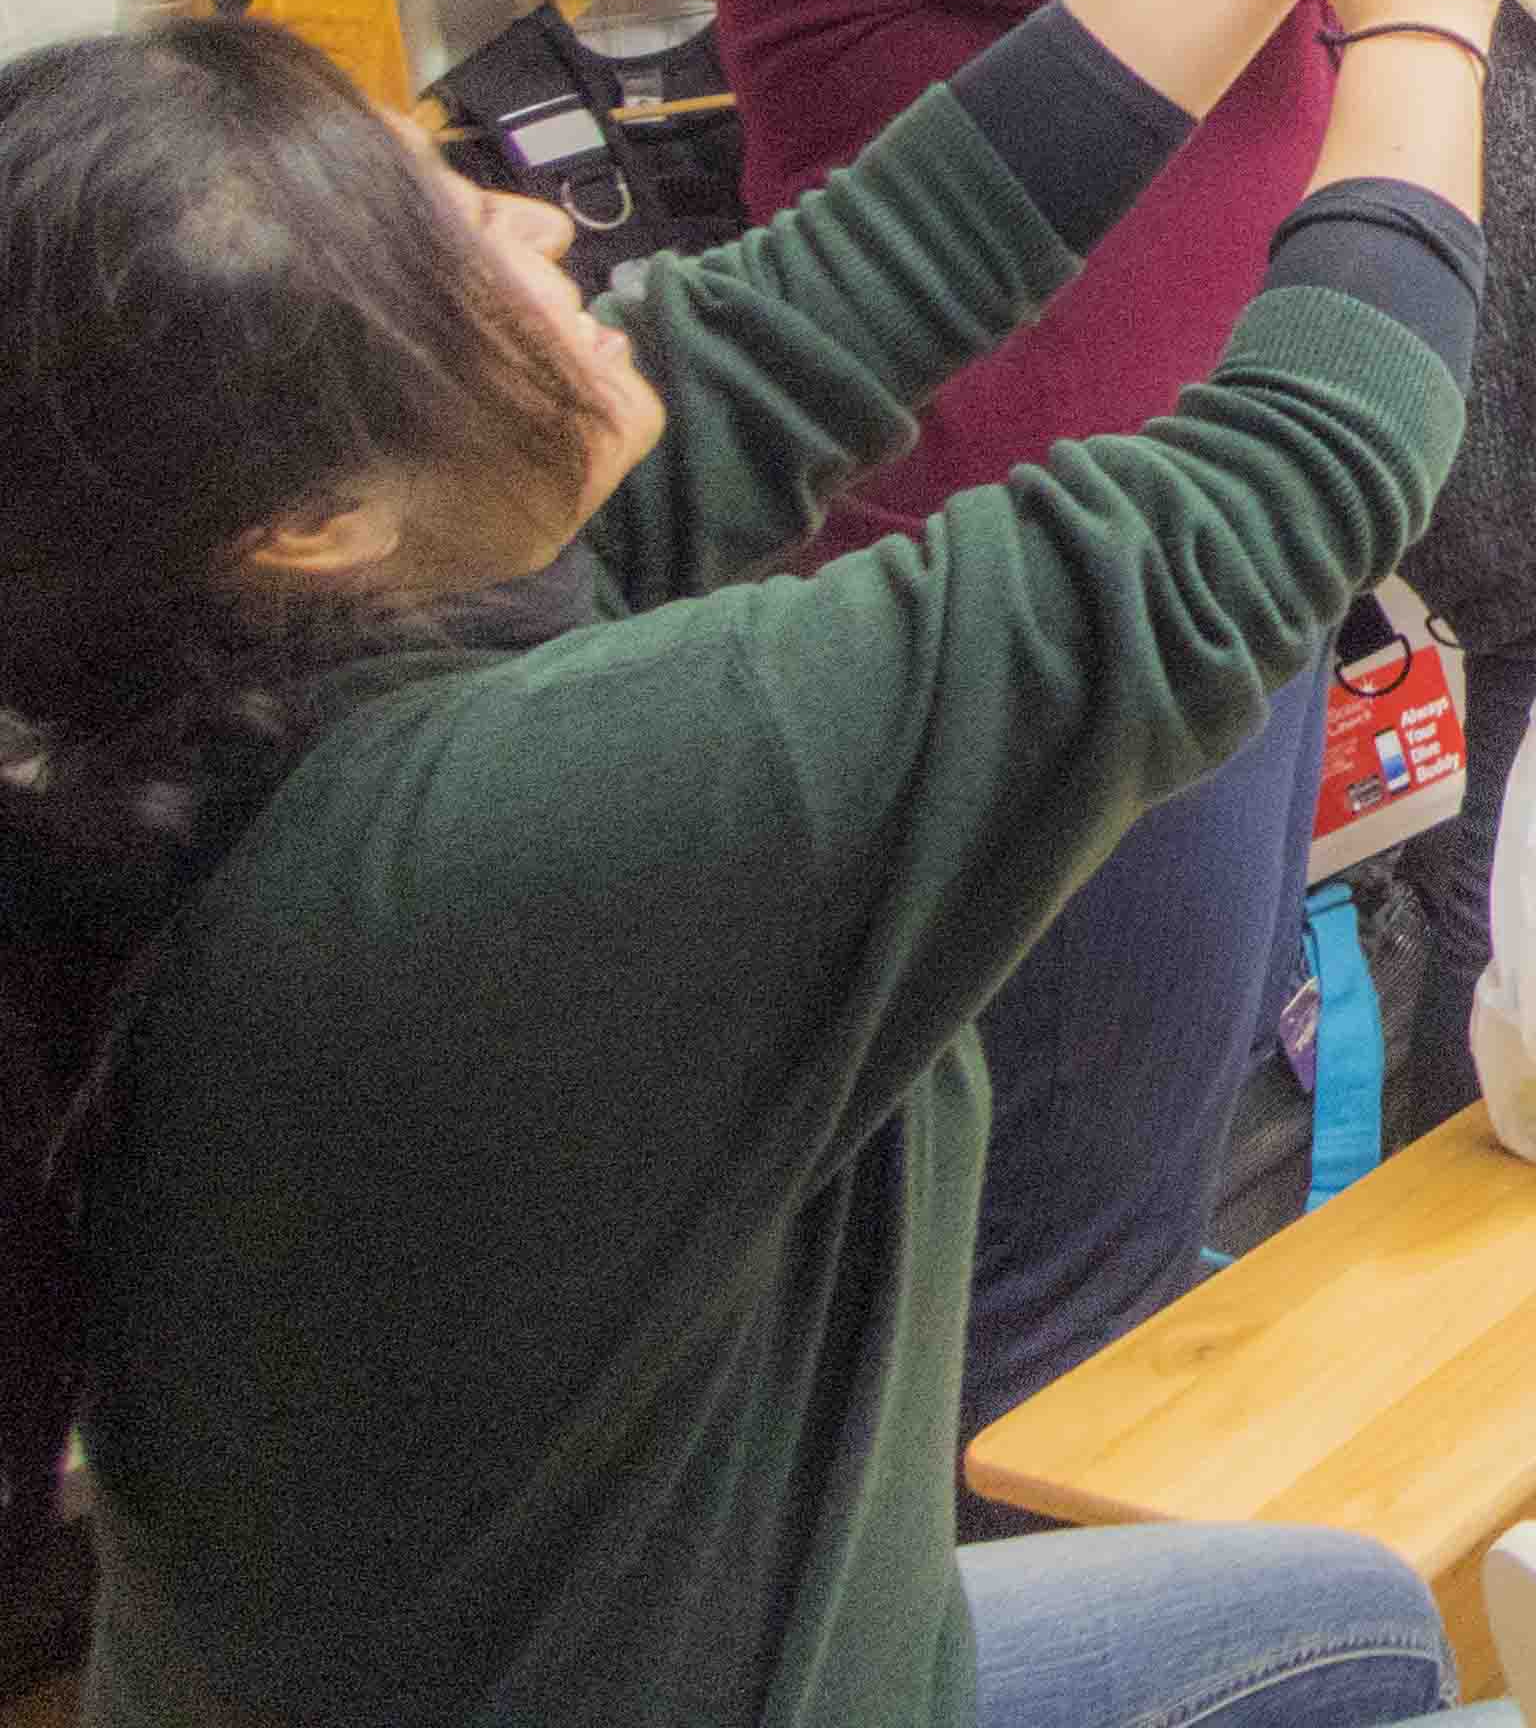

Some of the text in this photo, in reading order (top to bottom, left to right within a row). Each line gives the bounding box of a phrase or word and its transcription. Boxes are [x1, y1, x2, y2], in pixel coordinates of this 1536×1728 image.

[1400, 694, 1450, 729] Always
[1406, 720, 1437, 746] Your
[1416, 751, 1461, 784] Buddy
